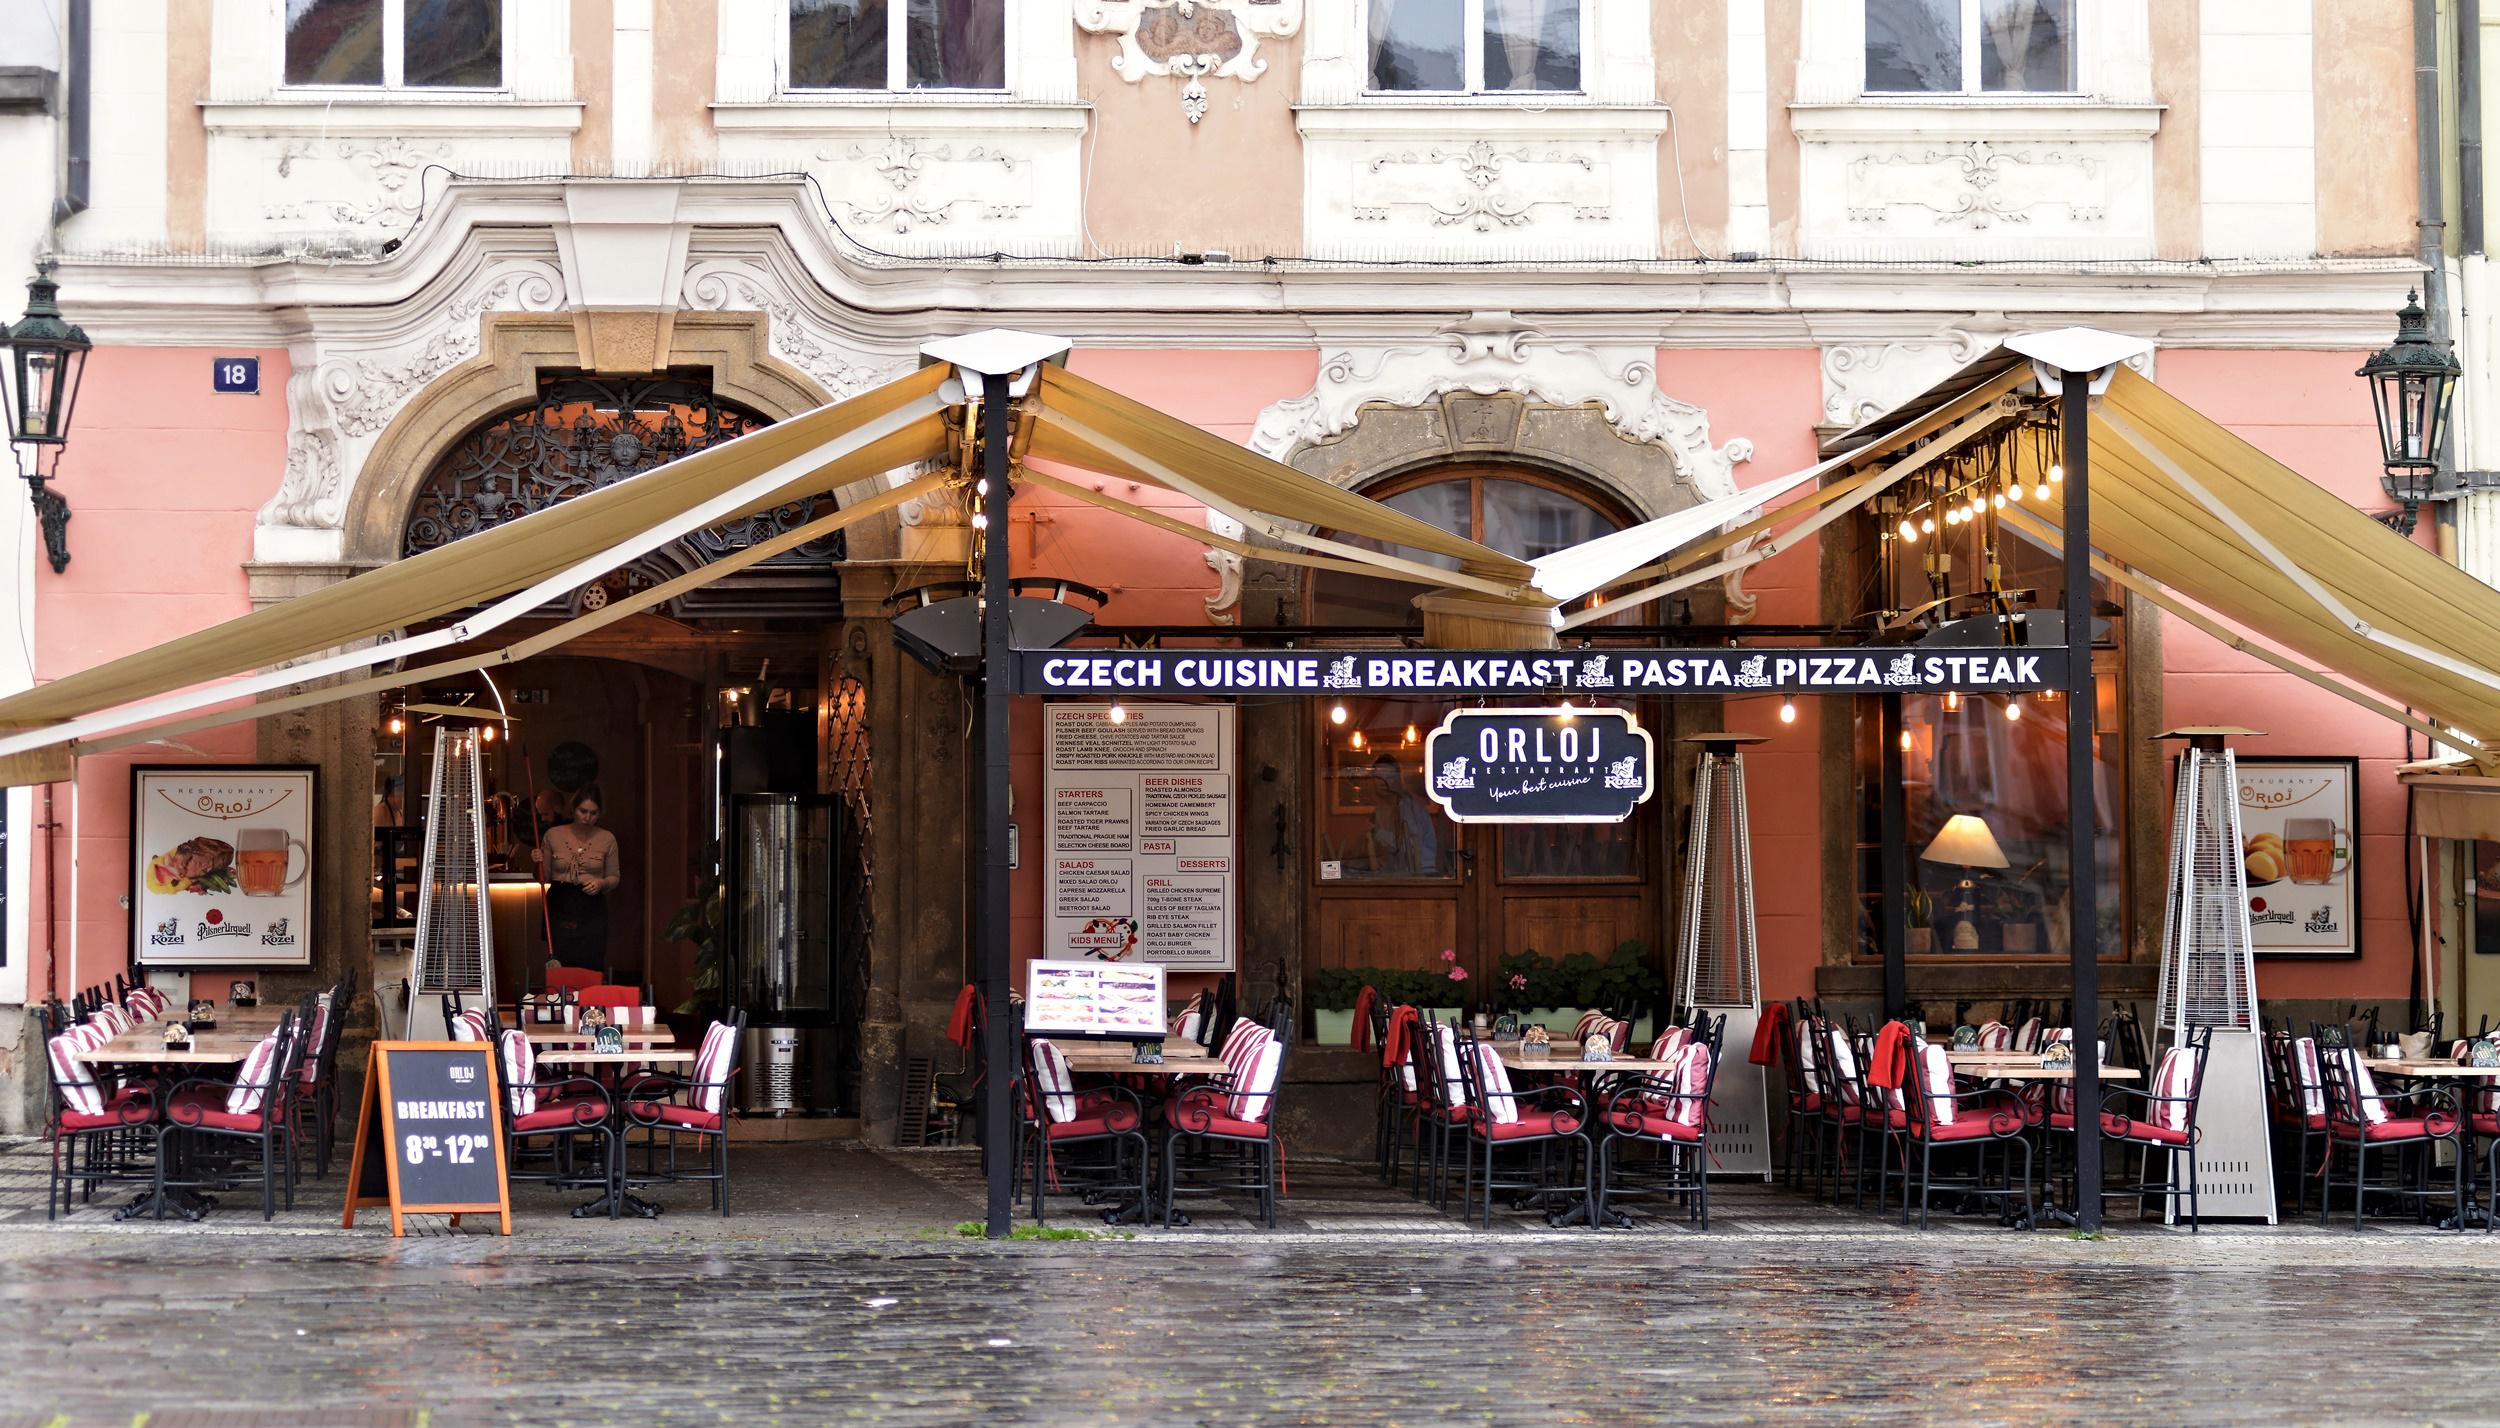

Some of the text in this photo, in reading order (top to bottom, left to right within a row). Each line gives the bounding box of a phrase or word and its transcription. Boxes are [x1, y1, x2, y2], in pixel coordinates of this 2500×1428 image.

[224, 365, 246, 384] 18
[1043, 657, 2040, 688] CZECH CUISINE Kozel BREAKFAST Kozel PASTA Kozel PIZZA Kozel STEAK
[1480, 728, 1600, 763] ORLOJ
[1471, 767, 1610, 775] RESTAURANT
[1437, 776, 1475, 789] Kozel
[1604, 775, 1643, 788] Kozel
[1058, 790, 1103, 798] STARTERS
[1489, 776, 1591, 803] Your best cuisine
[2305, 922, 2338, 933] Kozel
[151, 934, 184, 945] Kozel
[261, 934, 295, 945] Kozel
[1071, 936, 1119, 945] KIDS MENU
[450, 1067, 474, 1079] ORLOJ
[397, 1101, 485, 1119] BREAKFAST
